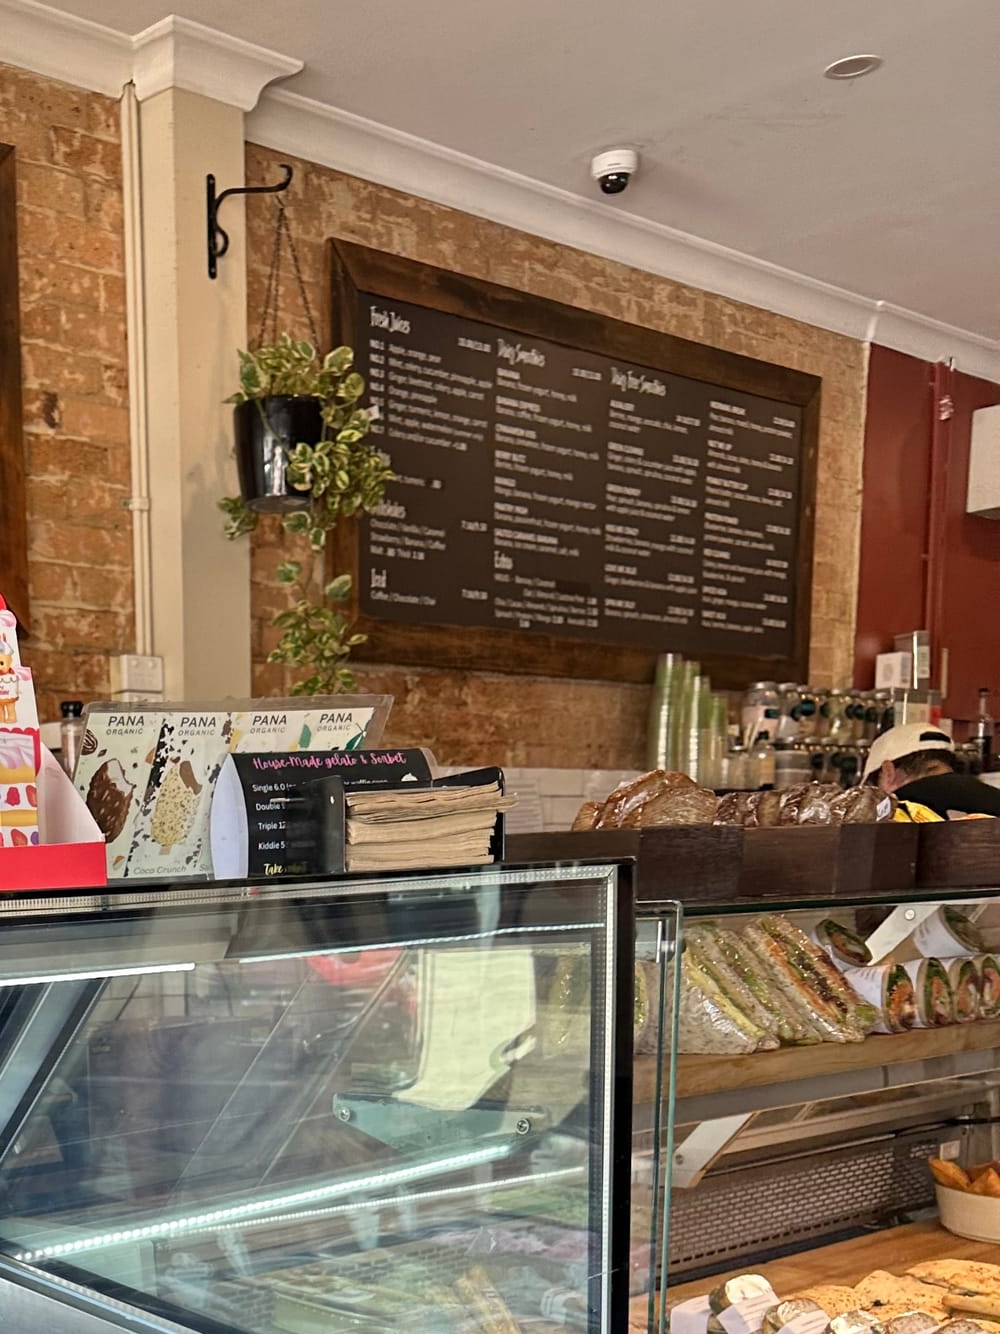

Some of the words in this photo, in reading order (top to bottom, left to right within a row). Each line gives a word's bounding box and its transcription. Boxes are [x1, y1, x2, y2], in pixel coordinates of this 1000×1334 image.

[108, 715, 145, 727] PANA
[180, 717, 217, 728] PANA
[252, 714, 287, 726] PANA
[319, 713, 353, 723] PANA
[106, 728, 144, 736] ORGANIC
[178, 729, 216, 737] ORGANIC
[250, 727, 286, 735] ORGANIC
[317, 724, 352, 732] ORGANIC
[252, 756, 324, 770] House-Made
[325, 753, 357, 769] gelato
[360, 756, 368, 765] &
[371, 752, 407, 765] Sorbet
[252, 784, 273, 793] Single
[255, 802, 281, 812] Double
[258, 822, 278, 831] Triple
[258, 841, 280, 850] Kiddie
[133, 867, 156, 875] Coco
[157, 865, 187, 874] Crunch
[263, 863, 283, 876] Take
